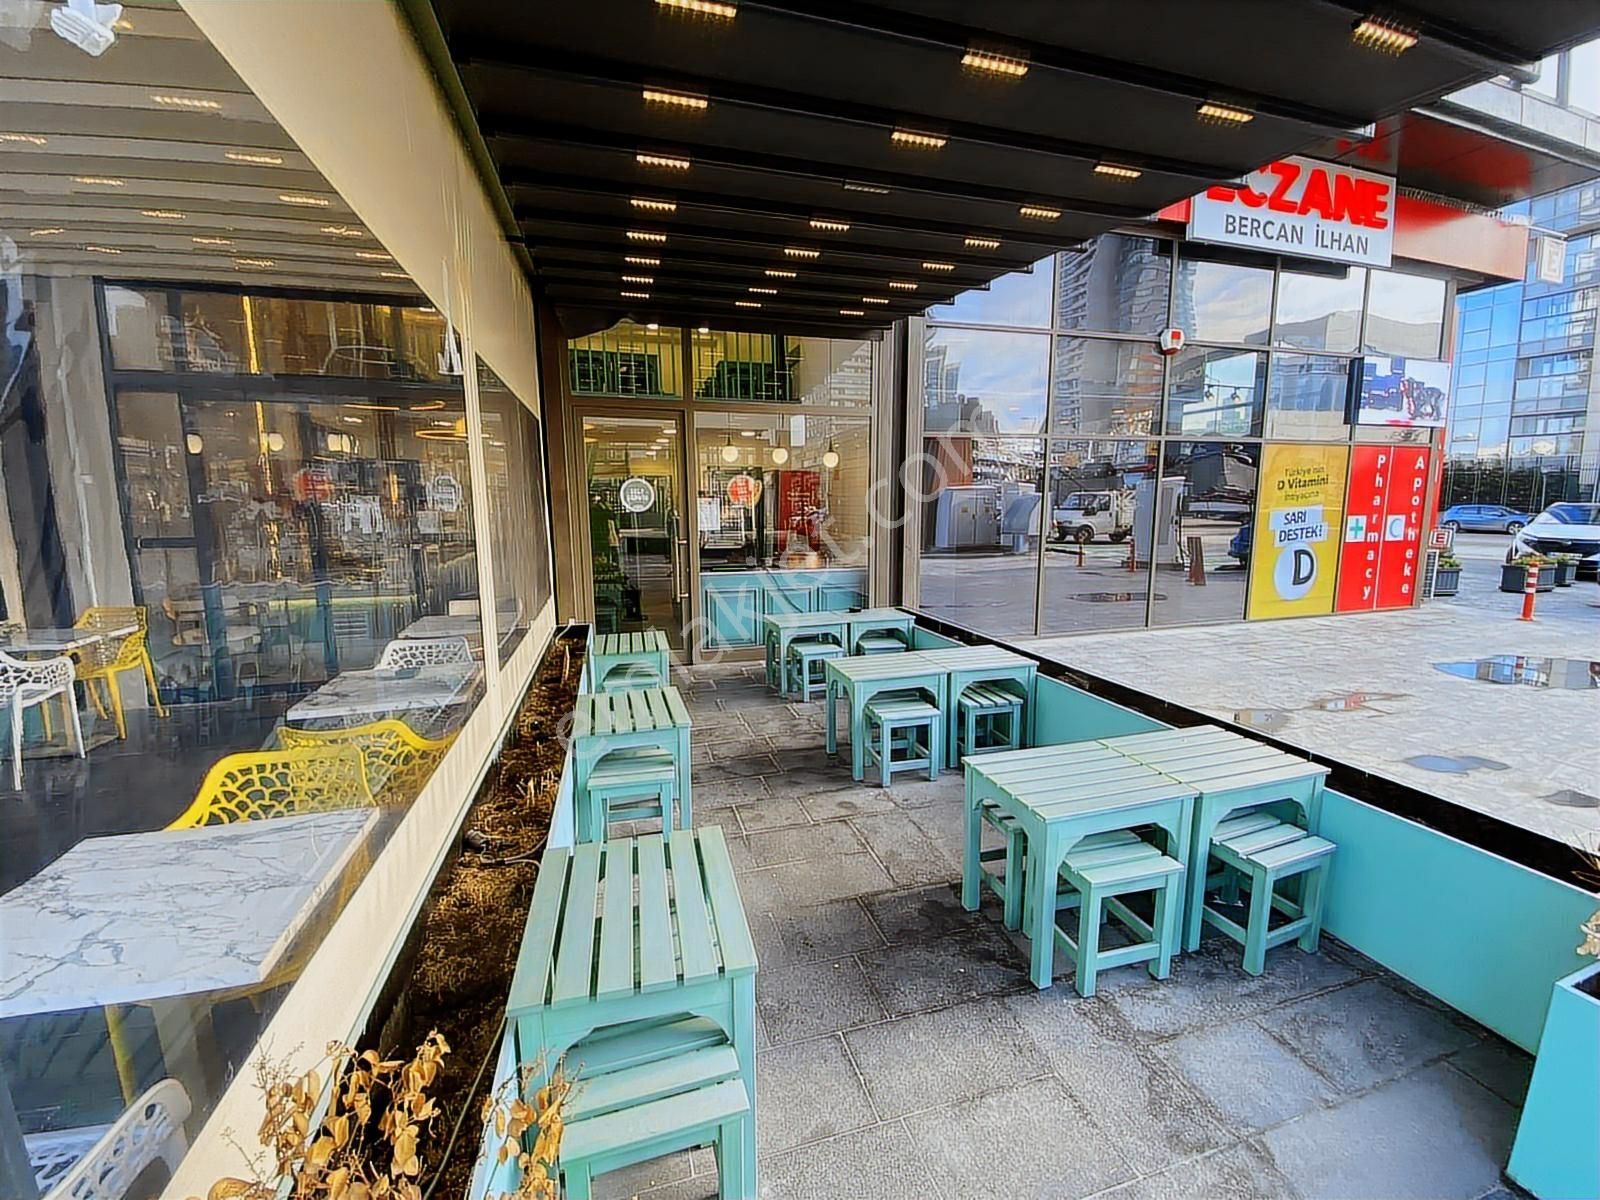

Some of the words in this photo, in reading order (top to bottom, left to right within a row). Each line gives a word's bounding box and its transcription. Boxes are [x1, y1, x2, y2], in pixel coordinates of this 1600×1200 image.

[1225, 213, 1304, 245] BERCAN
[1315, 223, 1369, 255] İLHAN
[1277, 480, 1285, 490] D
[1287, 474, 1329, 489] Vitamini
[1279, 525, 1323, 542] DESTEK!
[1284, 510, 1307, 525] SARI
[1363, 454, 1386, 600] Pharmacy
[1401, 455, 1425, 594] Apotheke
[1292, 549, 1315, 586] D
